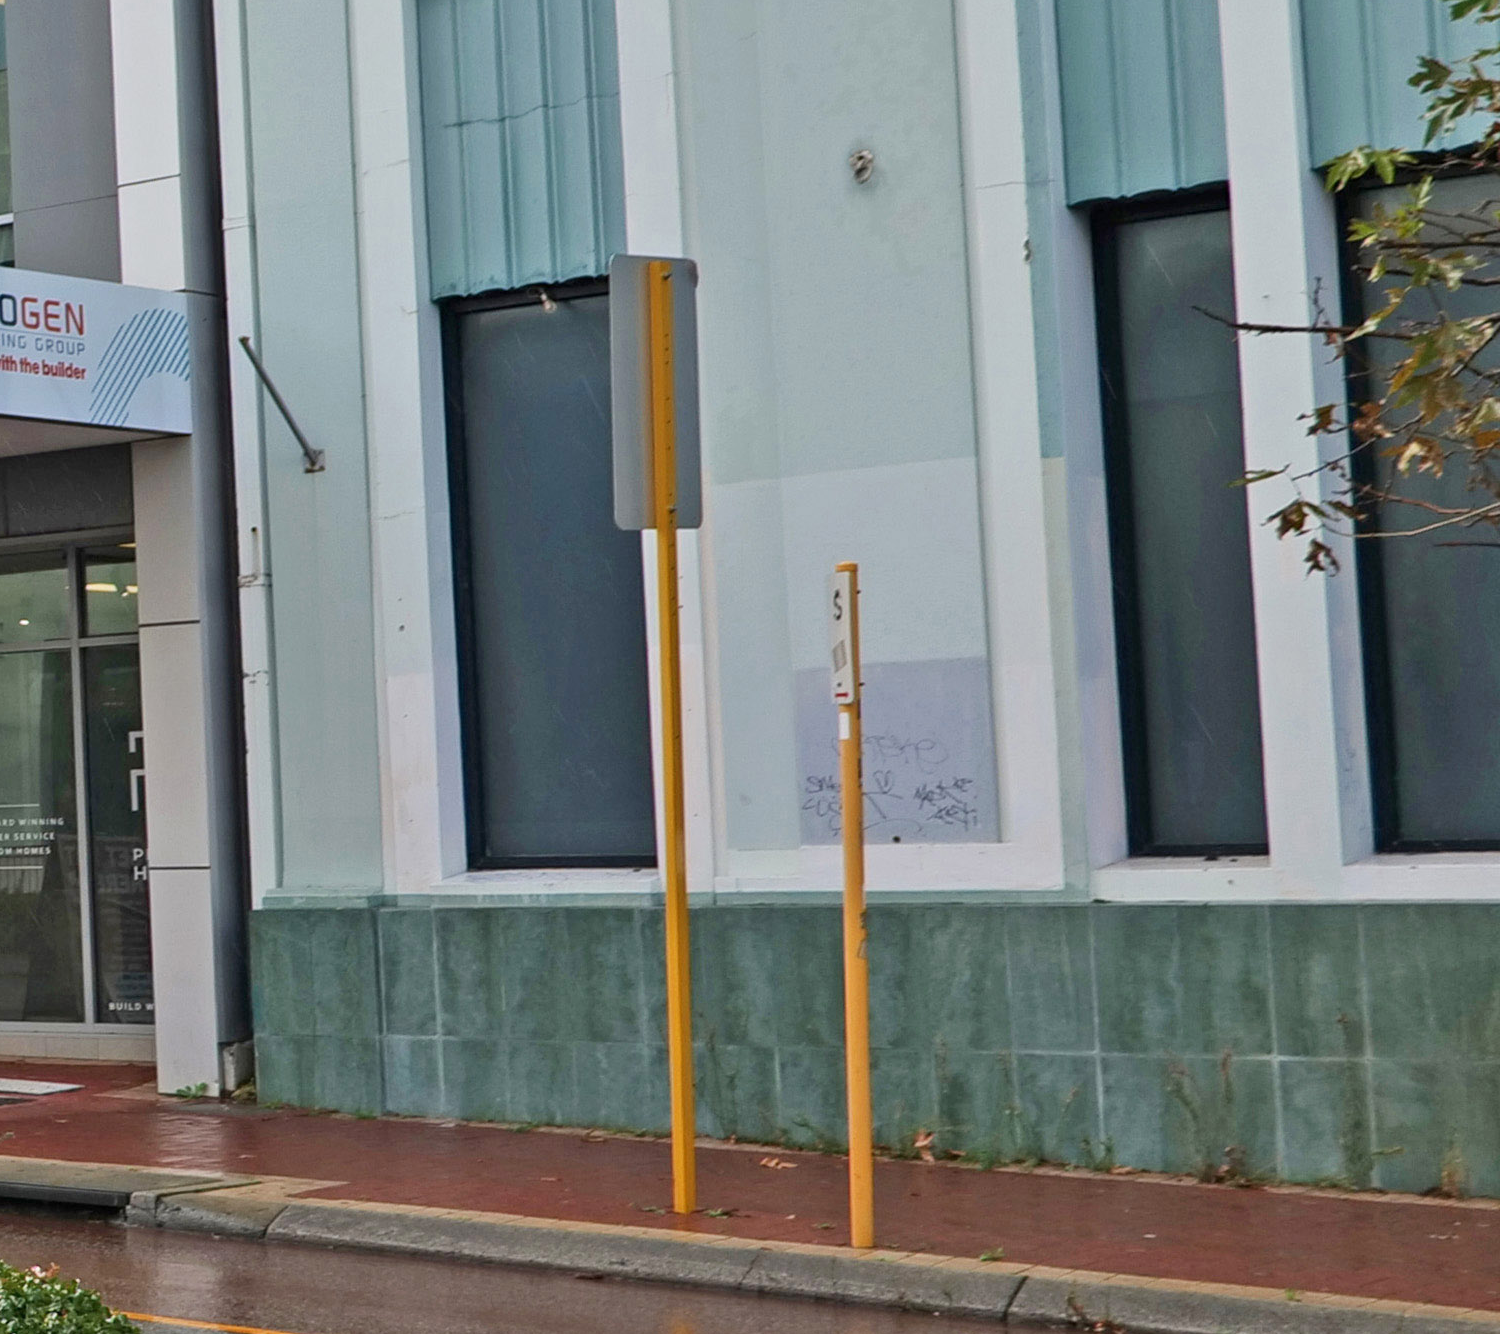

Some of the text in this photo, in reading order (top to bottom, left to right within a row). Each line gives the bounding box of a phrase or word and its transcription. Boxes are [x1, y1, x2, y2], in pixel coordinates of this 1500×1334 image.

[35, 337, 85, 356] GROUP
[19, 357, 40, 374] the
[42, 360, 87, 380] builder
[18, 817, 64, 826] WINNING
[13, 832, 55, 841] SERVICE
[16, 847, 51, 855] HOMES
[108, 1002, 142, 1011] BUILD
